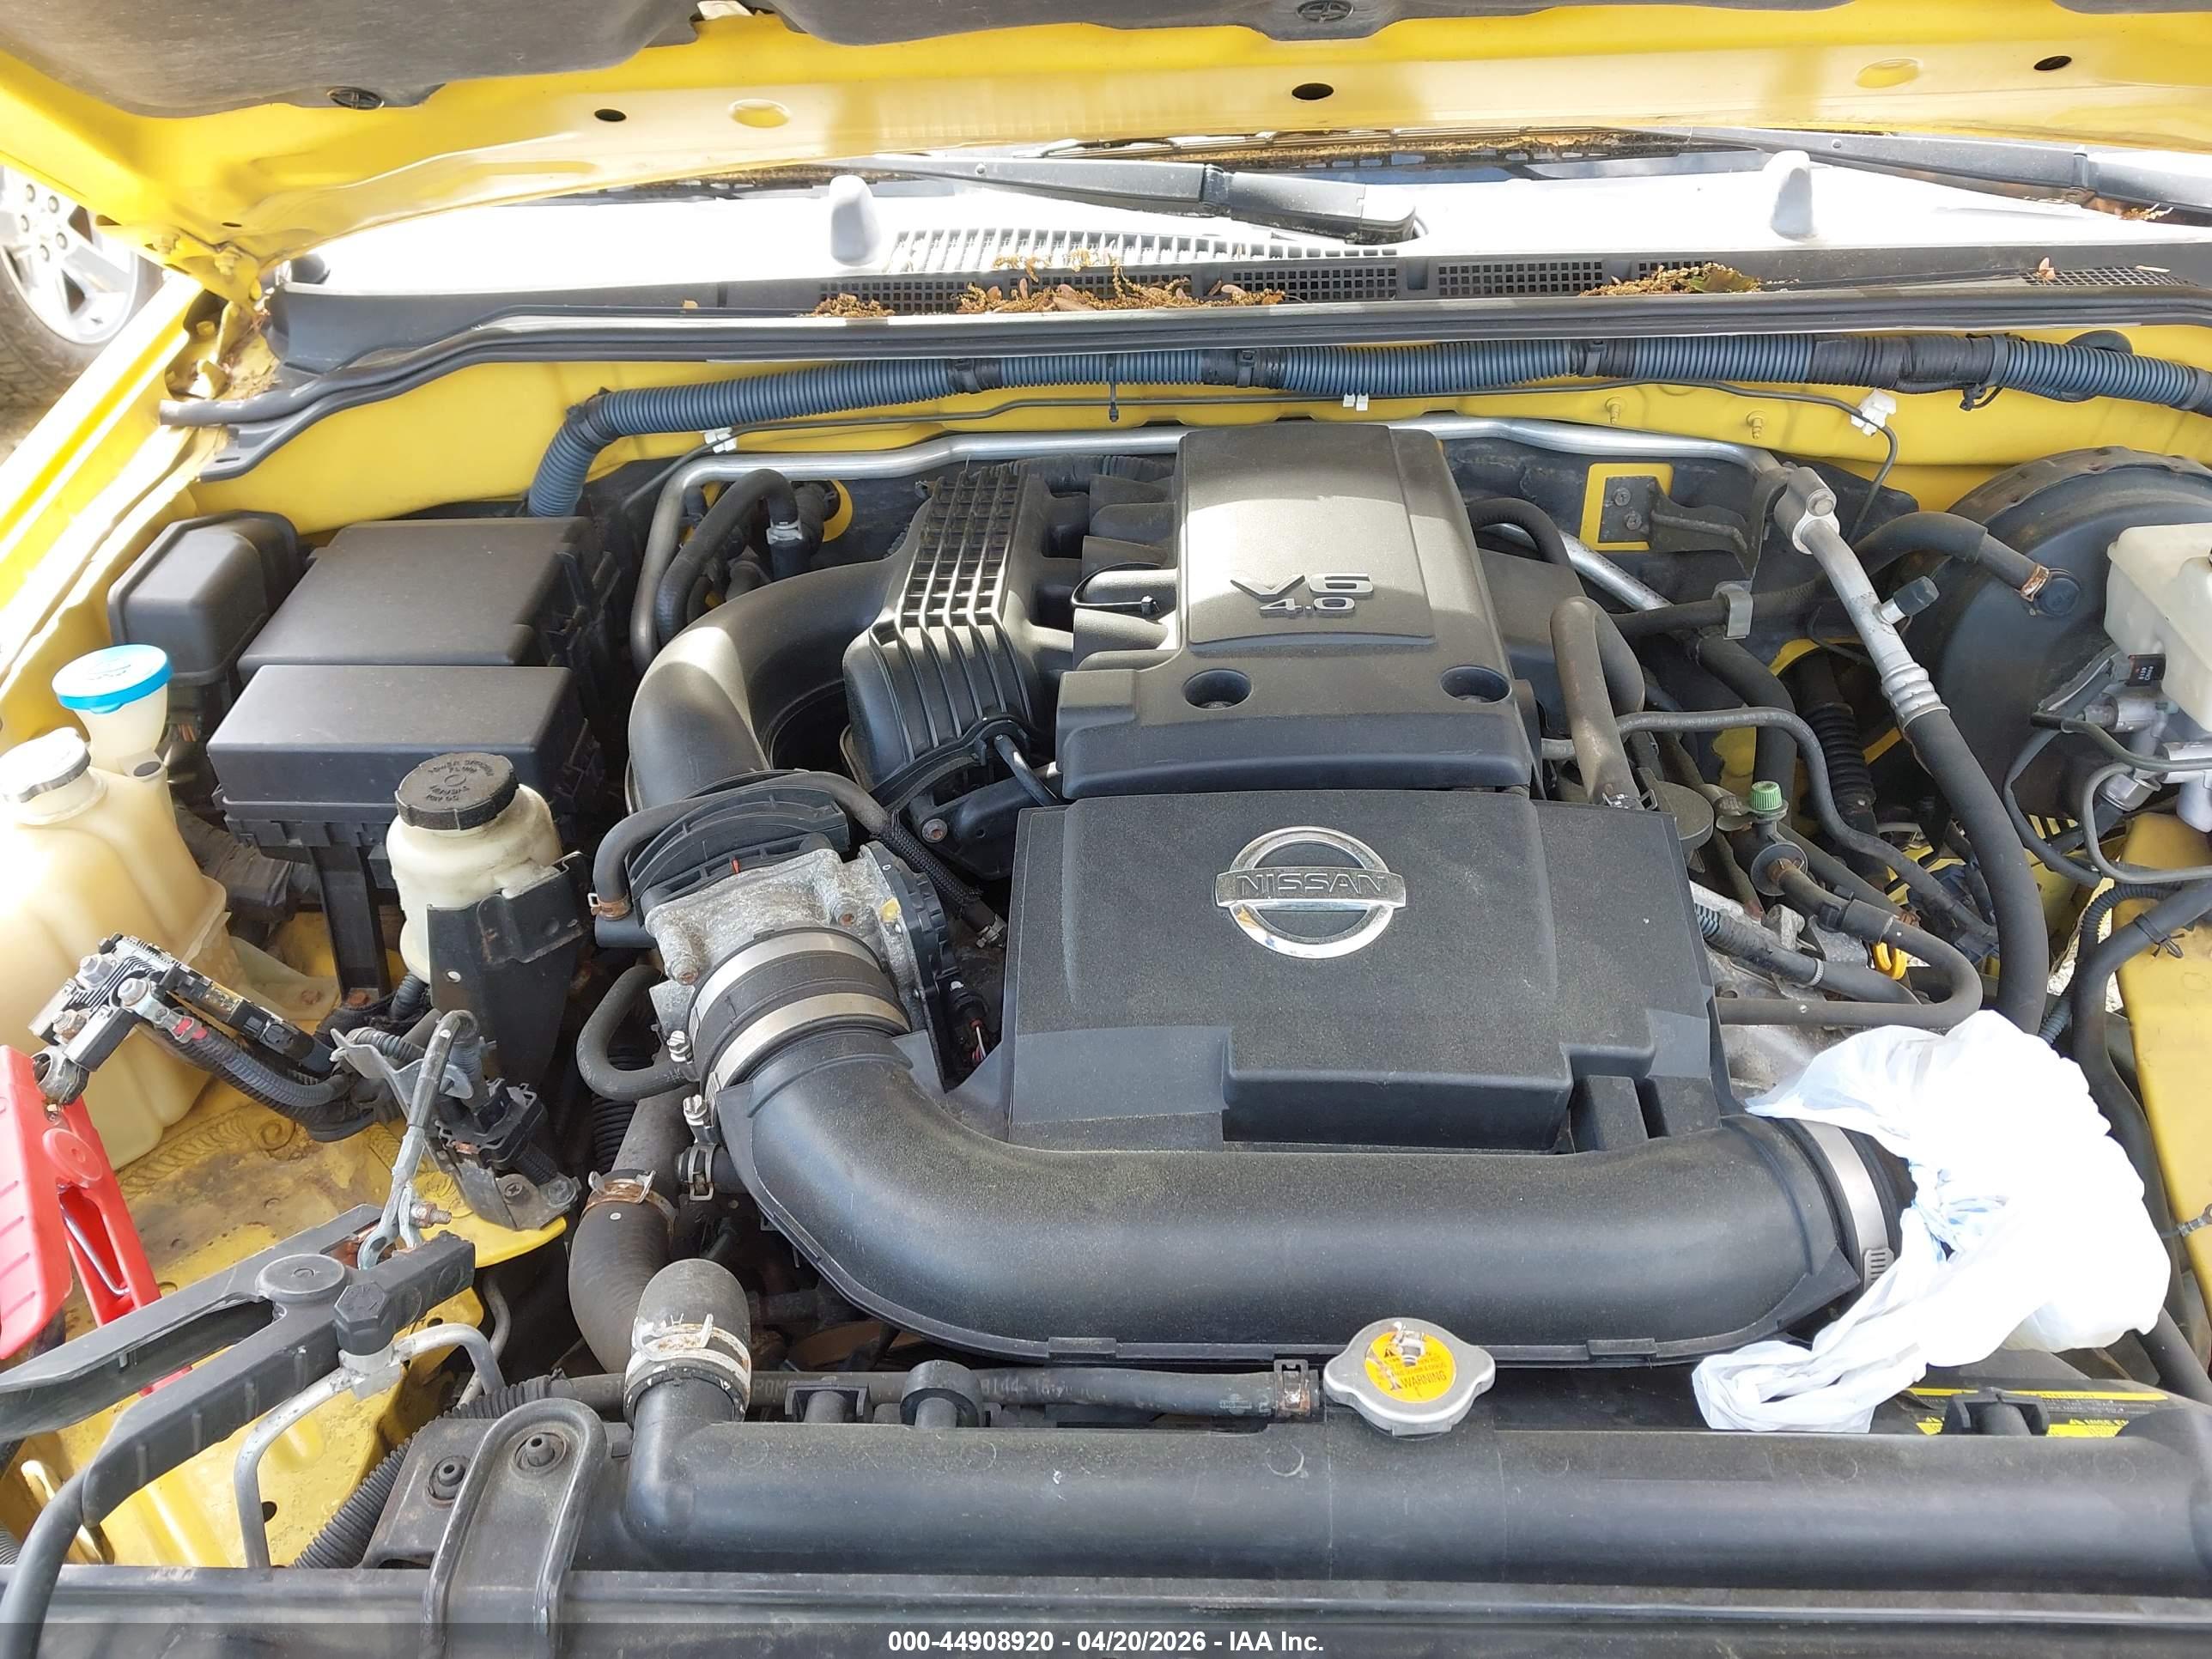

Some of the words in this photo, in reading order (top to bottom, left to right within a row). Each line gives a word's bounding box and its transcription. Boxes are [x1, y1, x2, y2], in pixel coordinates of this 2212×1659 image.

[1230, 573, 1374, 602] V6
[1260, 597, 1355, 618] 4.0
[1236, 872, 1385, 896] NISSAN
[1401, 1370, 1448, 1389] WARNING
